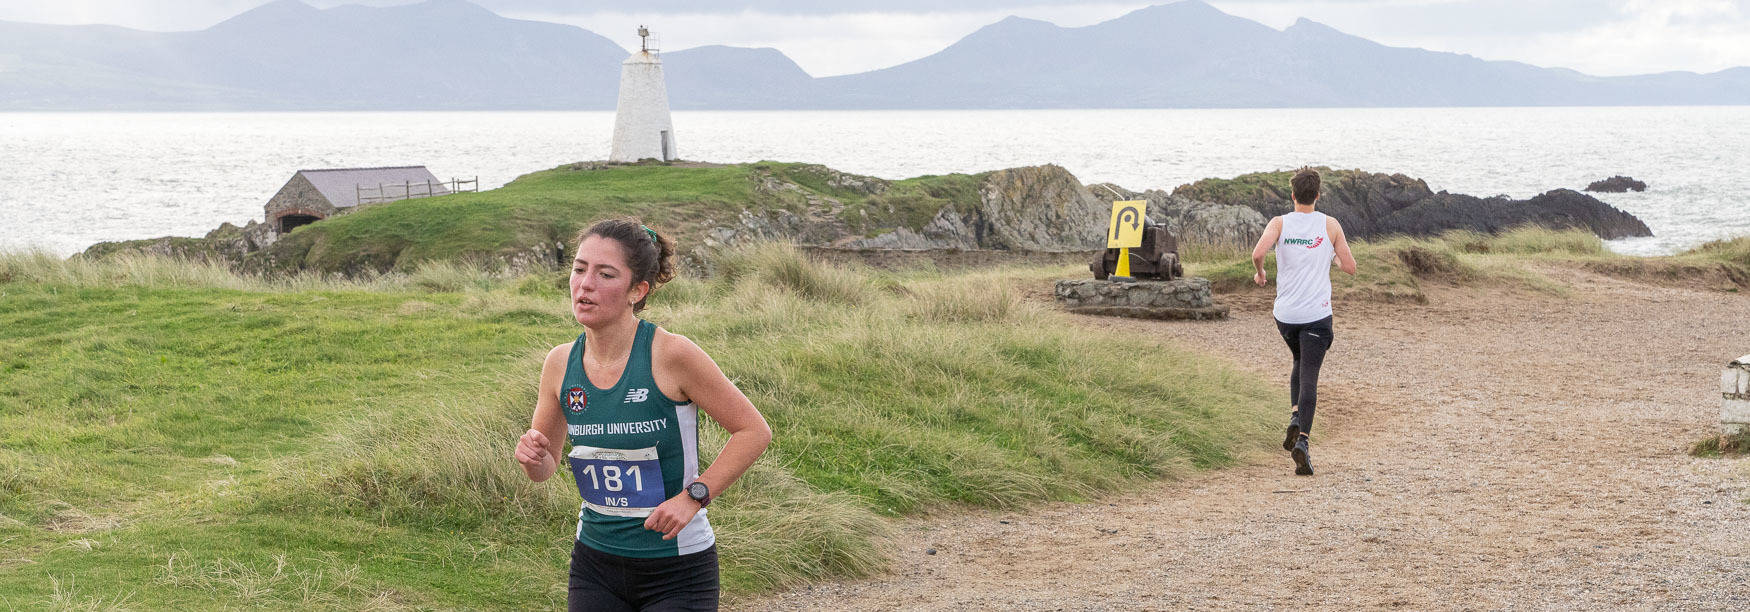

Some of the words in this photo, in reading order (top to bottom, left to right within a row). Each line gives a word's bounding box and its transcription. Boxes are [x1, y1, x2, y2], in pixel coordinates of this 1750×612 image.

[607, 418, 667, 434] UNIVERSITY
[583, 464, 643, 492] 181
[605, 496, 629, 507] IN/S
